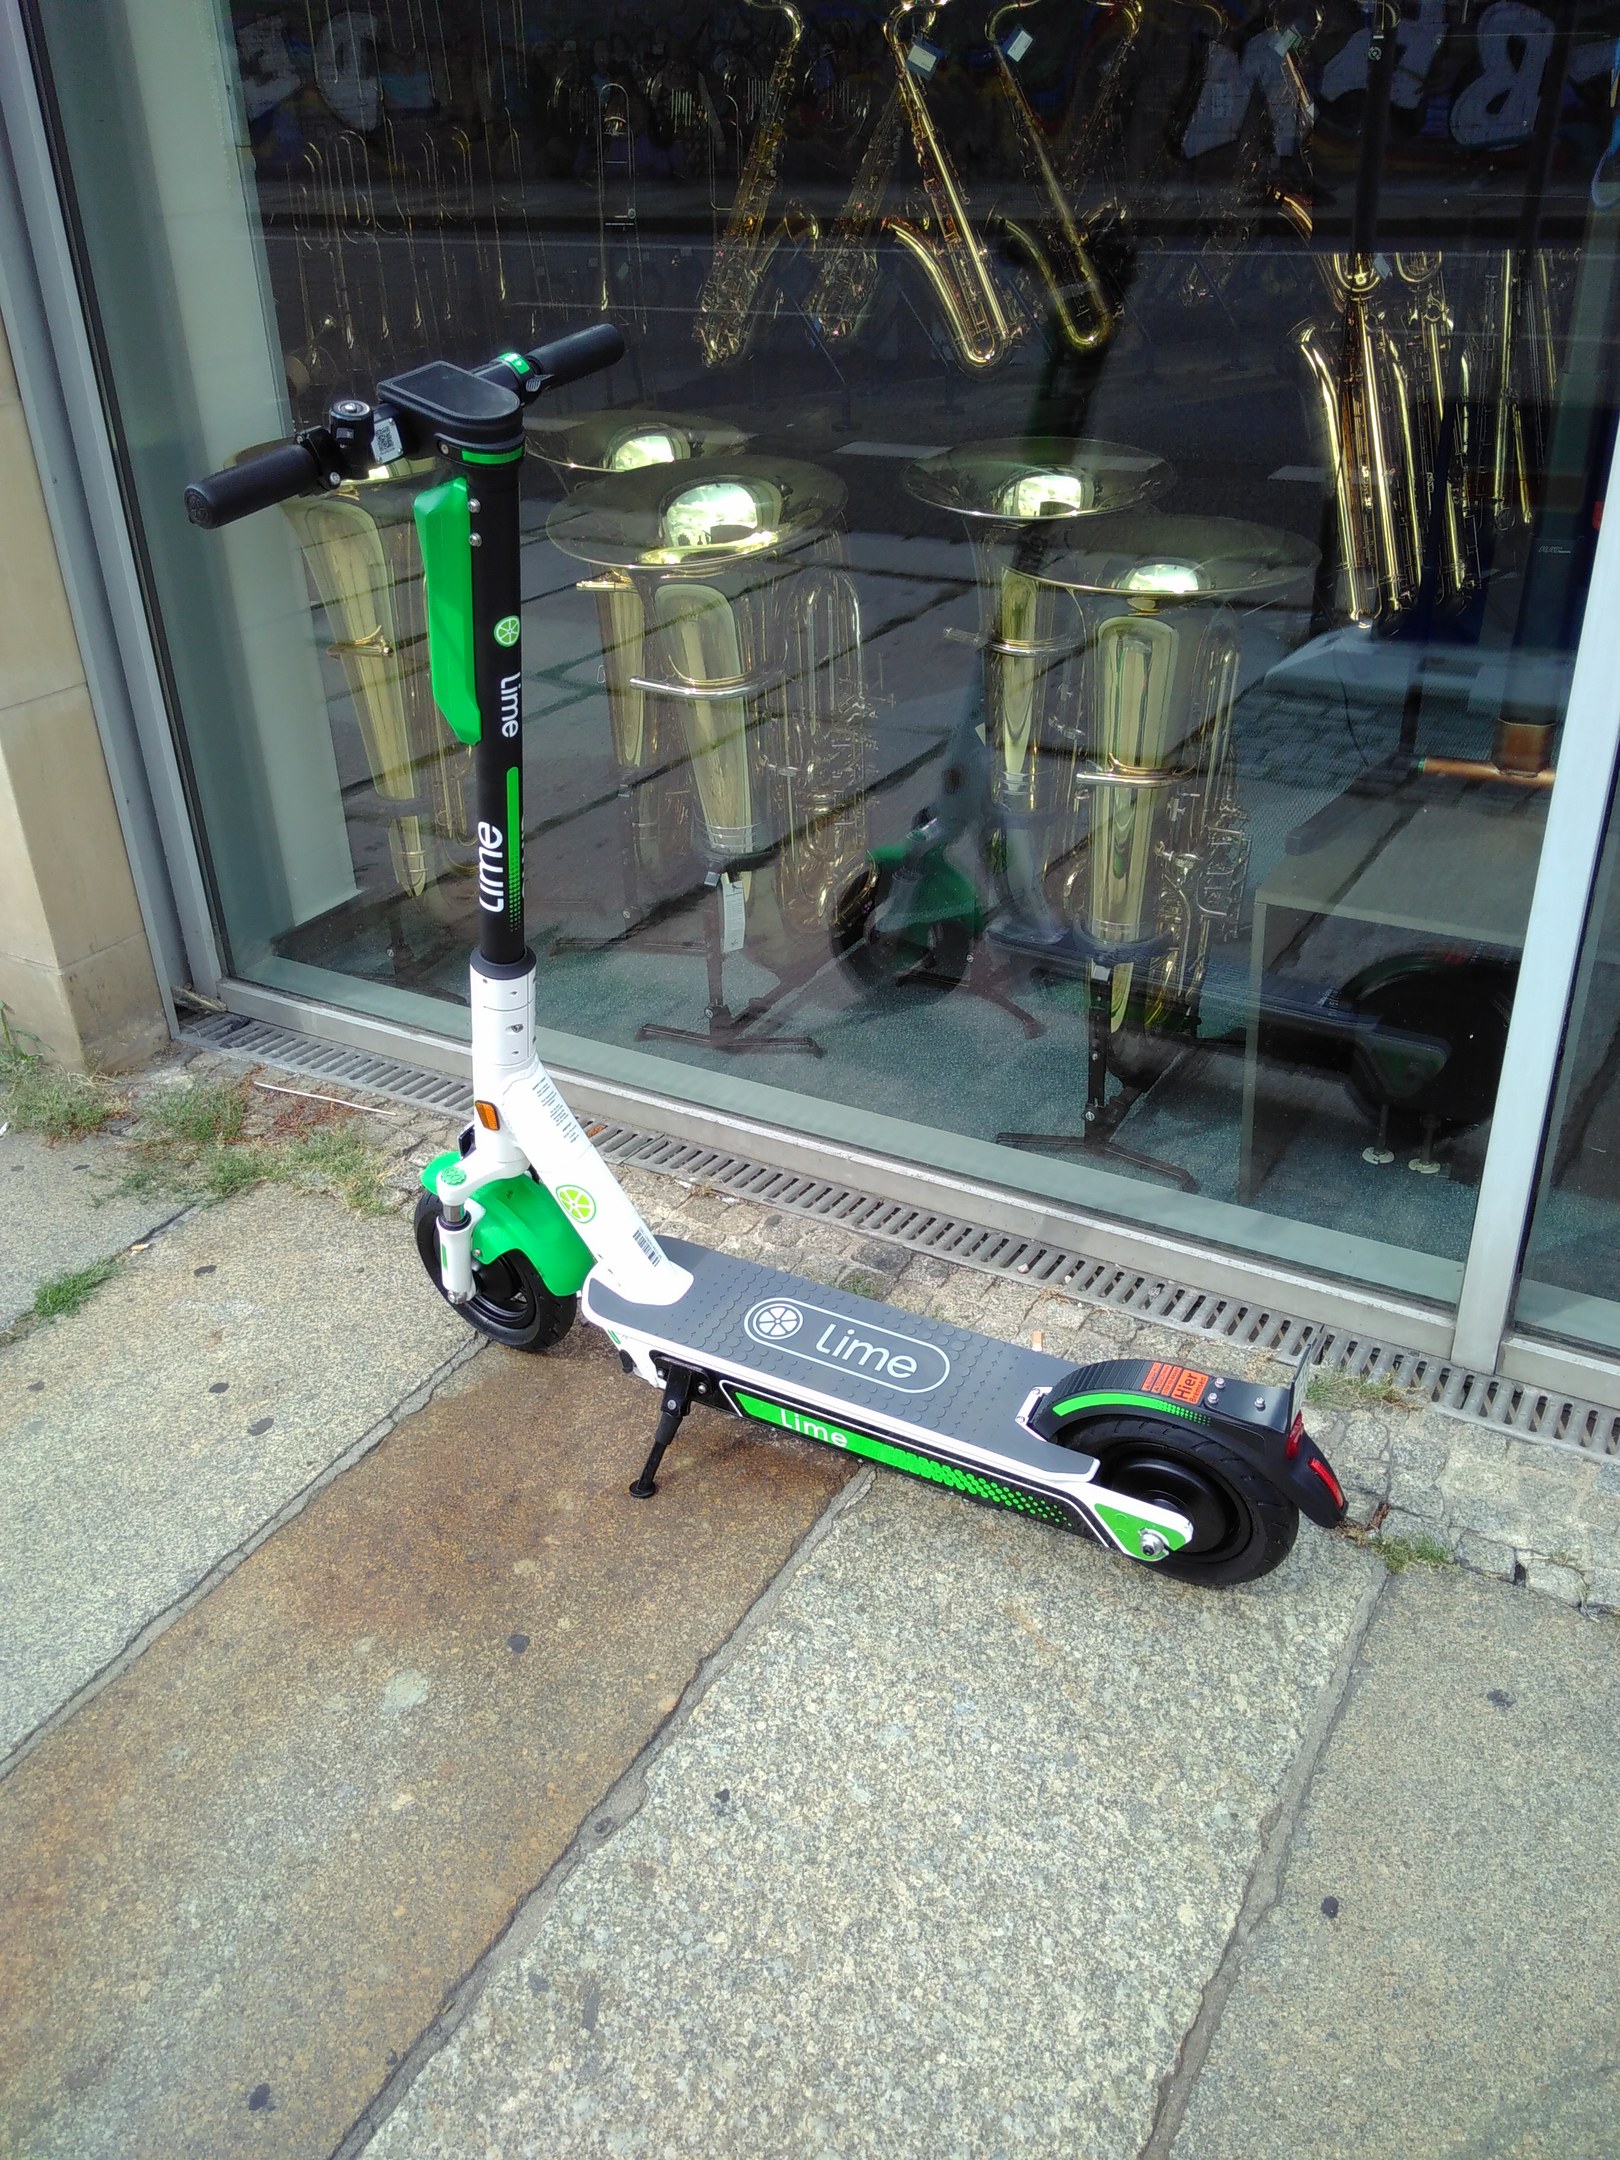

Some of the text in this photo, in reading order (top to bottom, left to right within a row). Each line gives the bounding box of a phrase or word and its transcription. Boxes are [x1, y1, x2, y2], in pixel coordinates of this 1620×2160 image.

[500, 671, 521, 738] Lime
[477, 820, 504, 913] Lime
[815, 1323, 918, 1379] Lime
[1174, 1372, 1198, 1400] Hier
[780, 1408, 848, 1448] Lime
